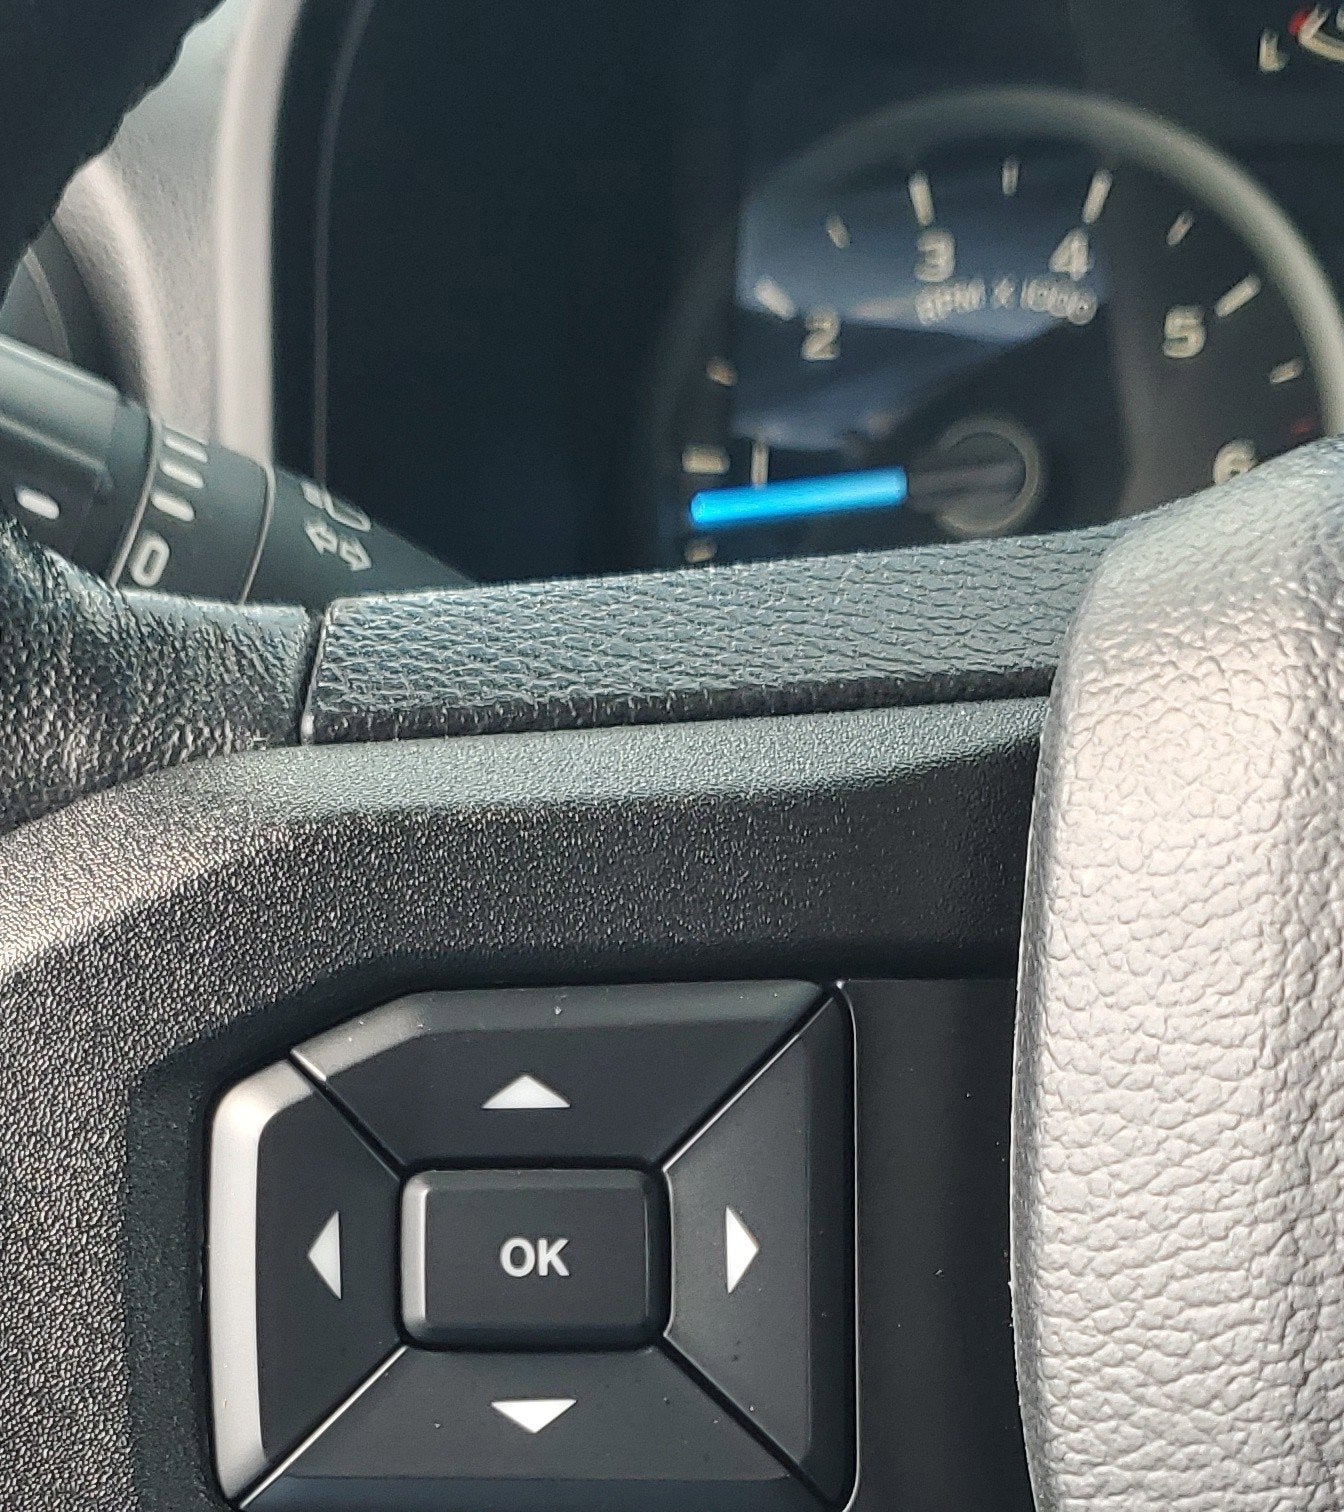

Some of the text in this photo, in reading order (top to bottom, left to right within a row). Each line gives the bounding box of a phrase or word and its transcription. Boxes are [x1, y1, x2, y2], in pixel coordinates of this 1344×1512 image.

[915, 229, 955, 283] 3
[1050, 227, 1092, 282] 4
[802, 304, 841, 361] 2
[1163, 305, 1205, 360] 5
[499, 1237, 570, 1277] OK
